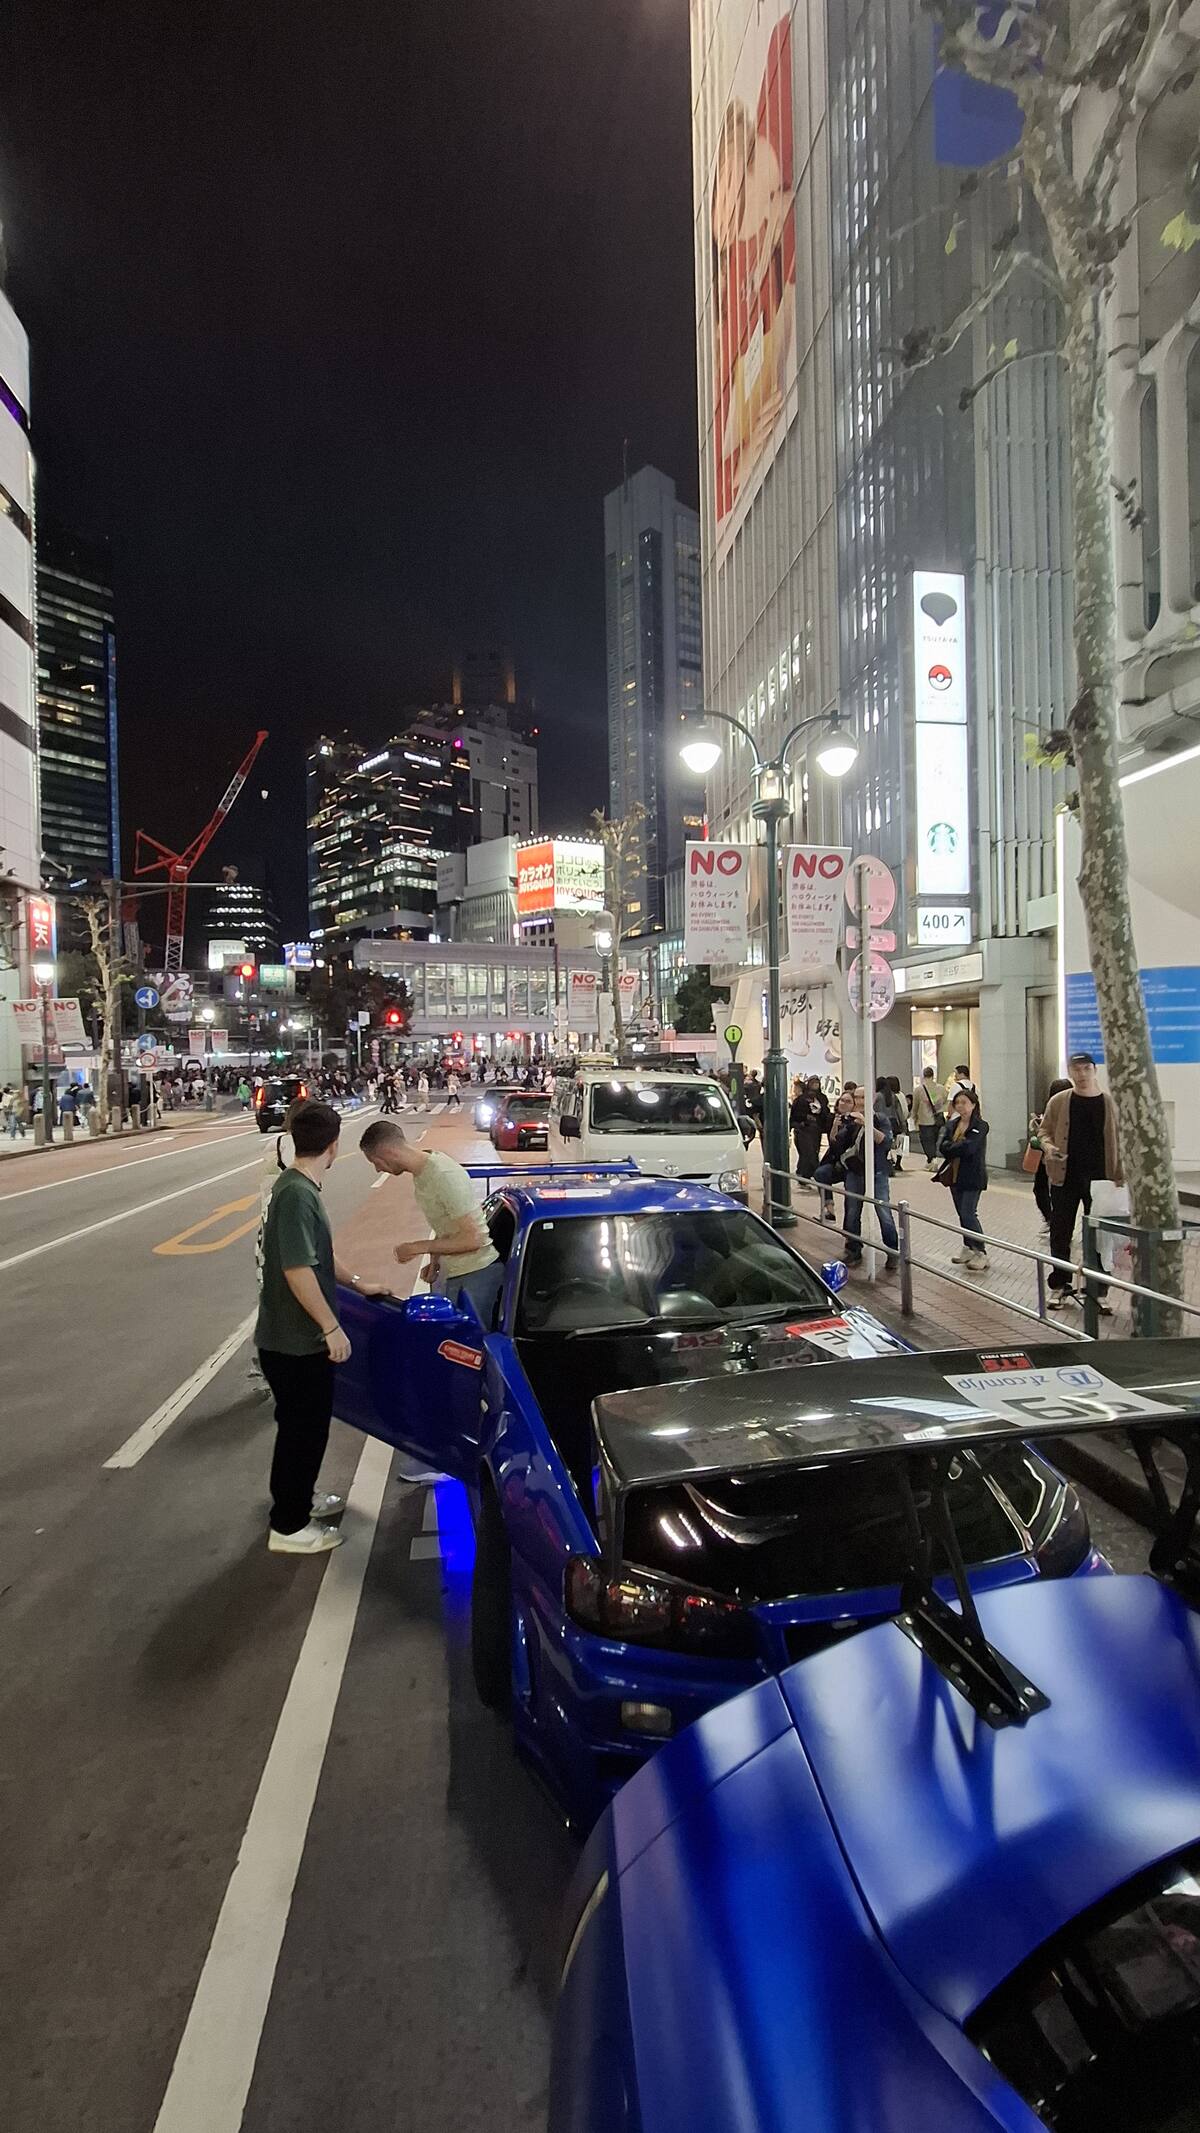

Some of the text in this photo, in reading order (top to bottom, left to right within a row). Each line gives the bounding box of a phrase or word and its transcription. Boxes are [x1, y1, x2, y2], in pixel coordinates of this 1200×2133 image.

[690, 850, 742, 876] NO
[792, 853, 844, 879] NO
[519, 863, 553, 883] カラオケ
[922, 914, 950, 929] 400
[573, 974, 596, 984] NO
[12, 1002, 37, 1012] NO
[54, 1001, 77, 1011] NO
[957, 1375, 1049, 1391] zf.com/jp
